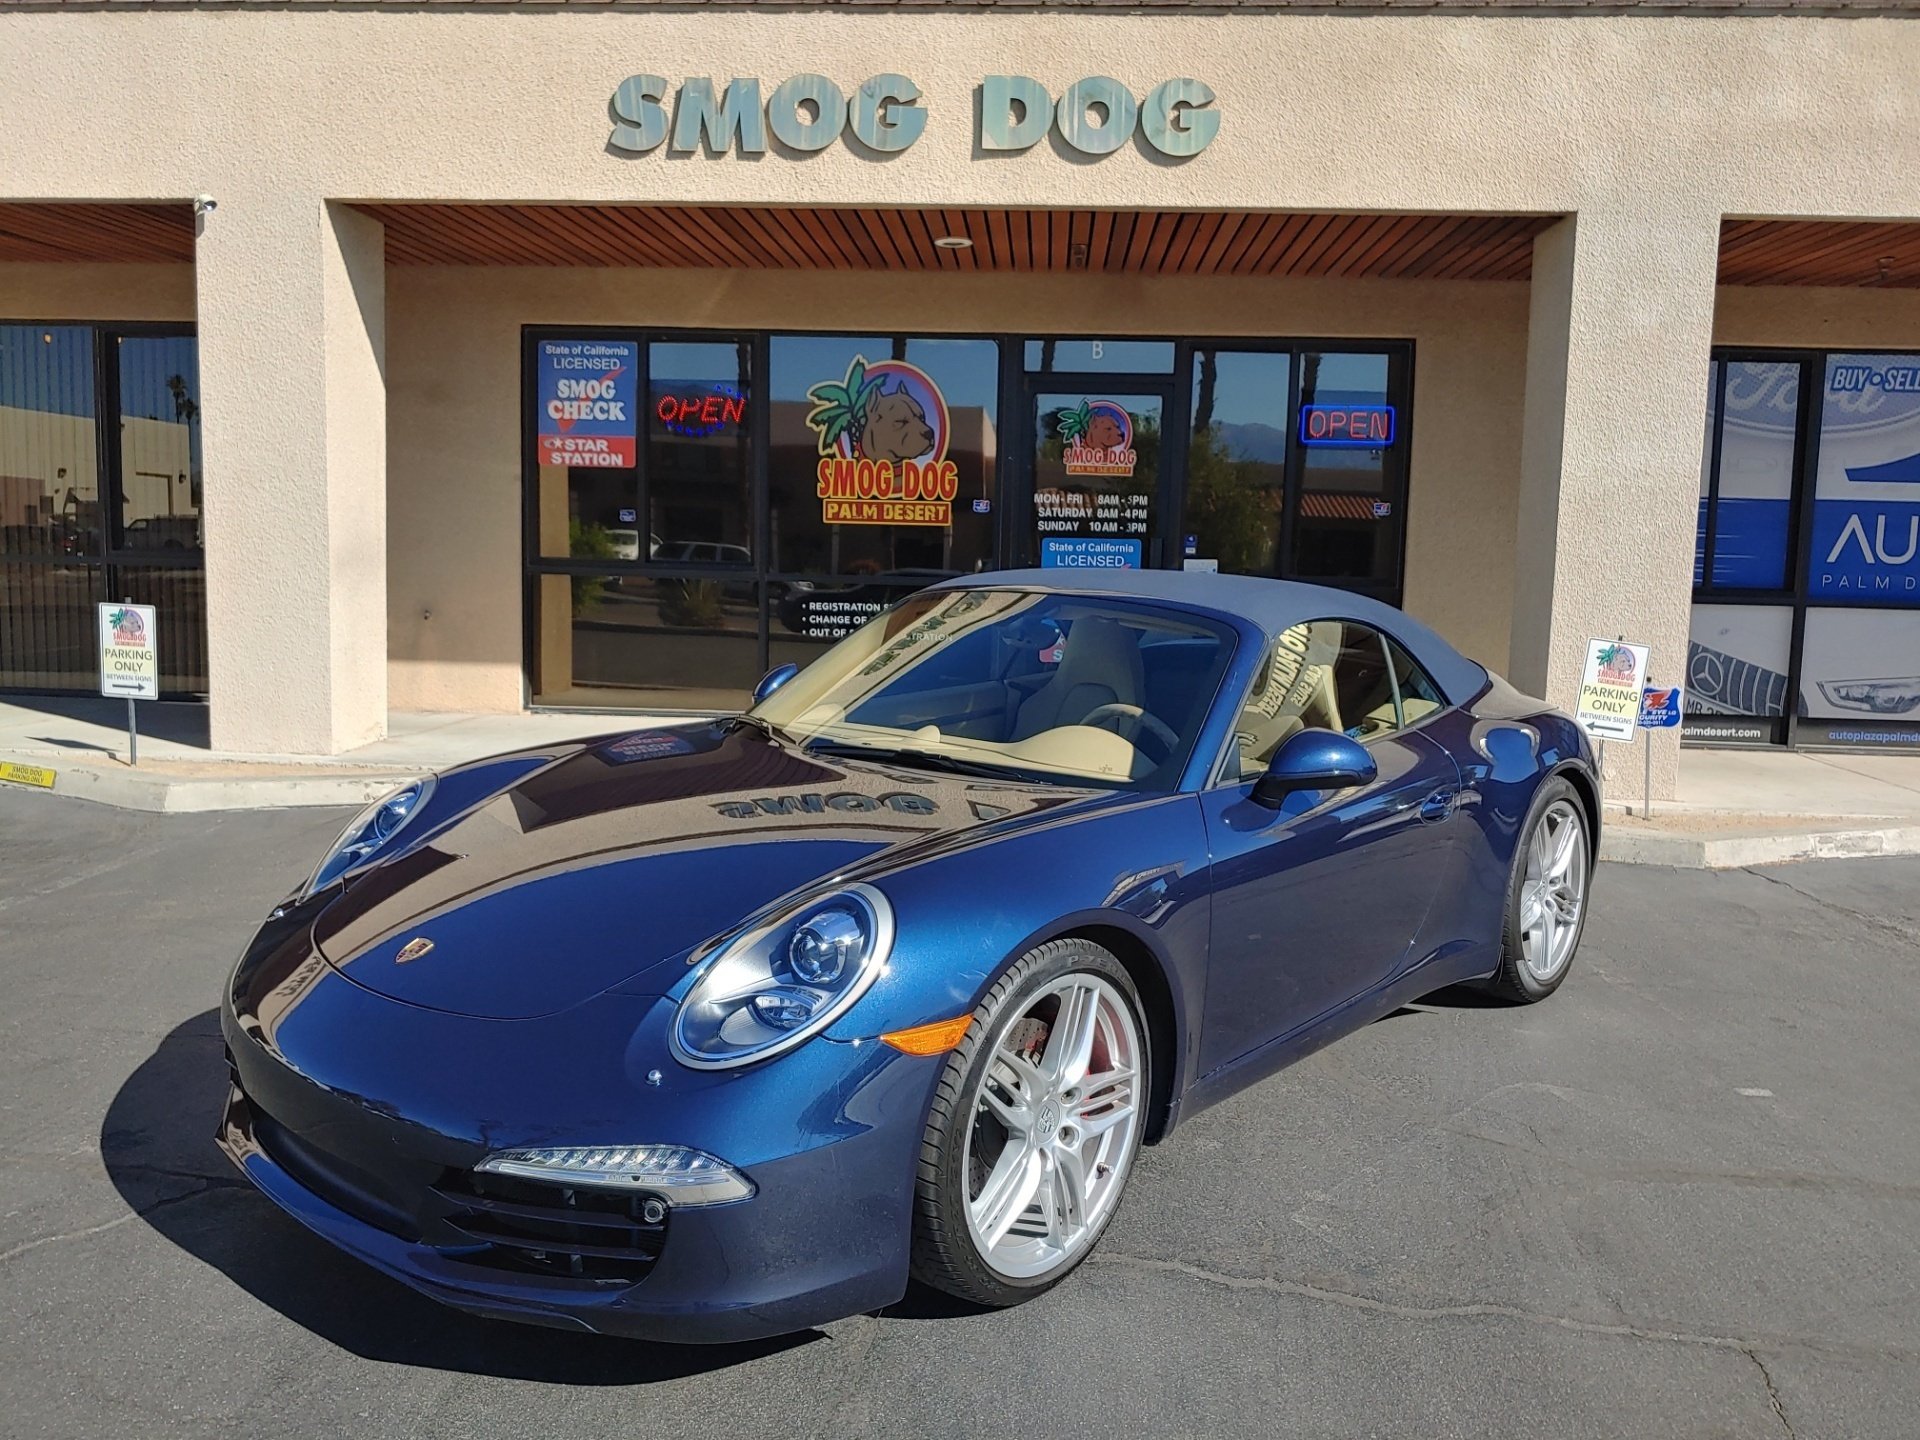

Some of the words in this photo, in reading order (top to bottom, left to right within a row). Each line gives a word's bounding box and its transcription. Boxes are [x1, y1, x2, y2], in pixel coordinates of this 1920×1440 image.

[609, 73, 928, 154] SMOG
[977, 74, 1221, 157] DOG
[545, 345, 569, 354] State
[571, 345, 581, 354] of
[583, 346, 629, 356] California
[1092, 341, 1103, 359] B
[553, 358, 620, 370] LICENSED
[557, 379, 616, 399] SMOG
[547, 400, 626, 421] CHECK
[659, 395, 745, 423] OPEN
[1309, 411, 1388, 438] OPEN
[564, 439, 609, 451] STAR
[550, 452, 624, 466] STATION
[1063, 448, 1103, 464] SMOG
[1108, 448, 1137, 465] DOG
[818, 459, 894, 499] SMOG
[902, 459, 958, 500] DOG
[1097, 495, 1119, 505] 8AM
[826, 503, 879, 519] PALM
[883, 504, 946, 521] DESERT
[1038, 508, 1092, 518] SATURDAY
[1097, 508, 1119, 519] 8AM
[1038, 520, 1079, 531] SUNDAY
[1049, 542, 1073, 552] State
[1075, 543, 1086, 552] of
[1088, 543, 1134, 553] California
[1057, 555, 1125, 567] LICENSED
[1822, 574, 1890, 589] PALM
[809, 602, 880, 612] REGISTRATION
[809, 615, 850, 624] CHANGE
[853, 616, 867, 624] OF
[809, 628, 831, 637] OUT
[833, 628, 846, 637] OF
[105, 648, 152, 661] PARKING
[114, 661, 143, 673] ONLY
[106, 673, 134, 681] BETWEEN
[1583, 685, 1638, 702] PARKING
[1592, 699, 1626, 713] ONLY
[1580, 711, 1612, 721] BETWEEN
[1612, 716, 1632, 725] SIGNS
